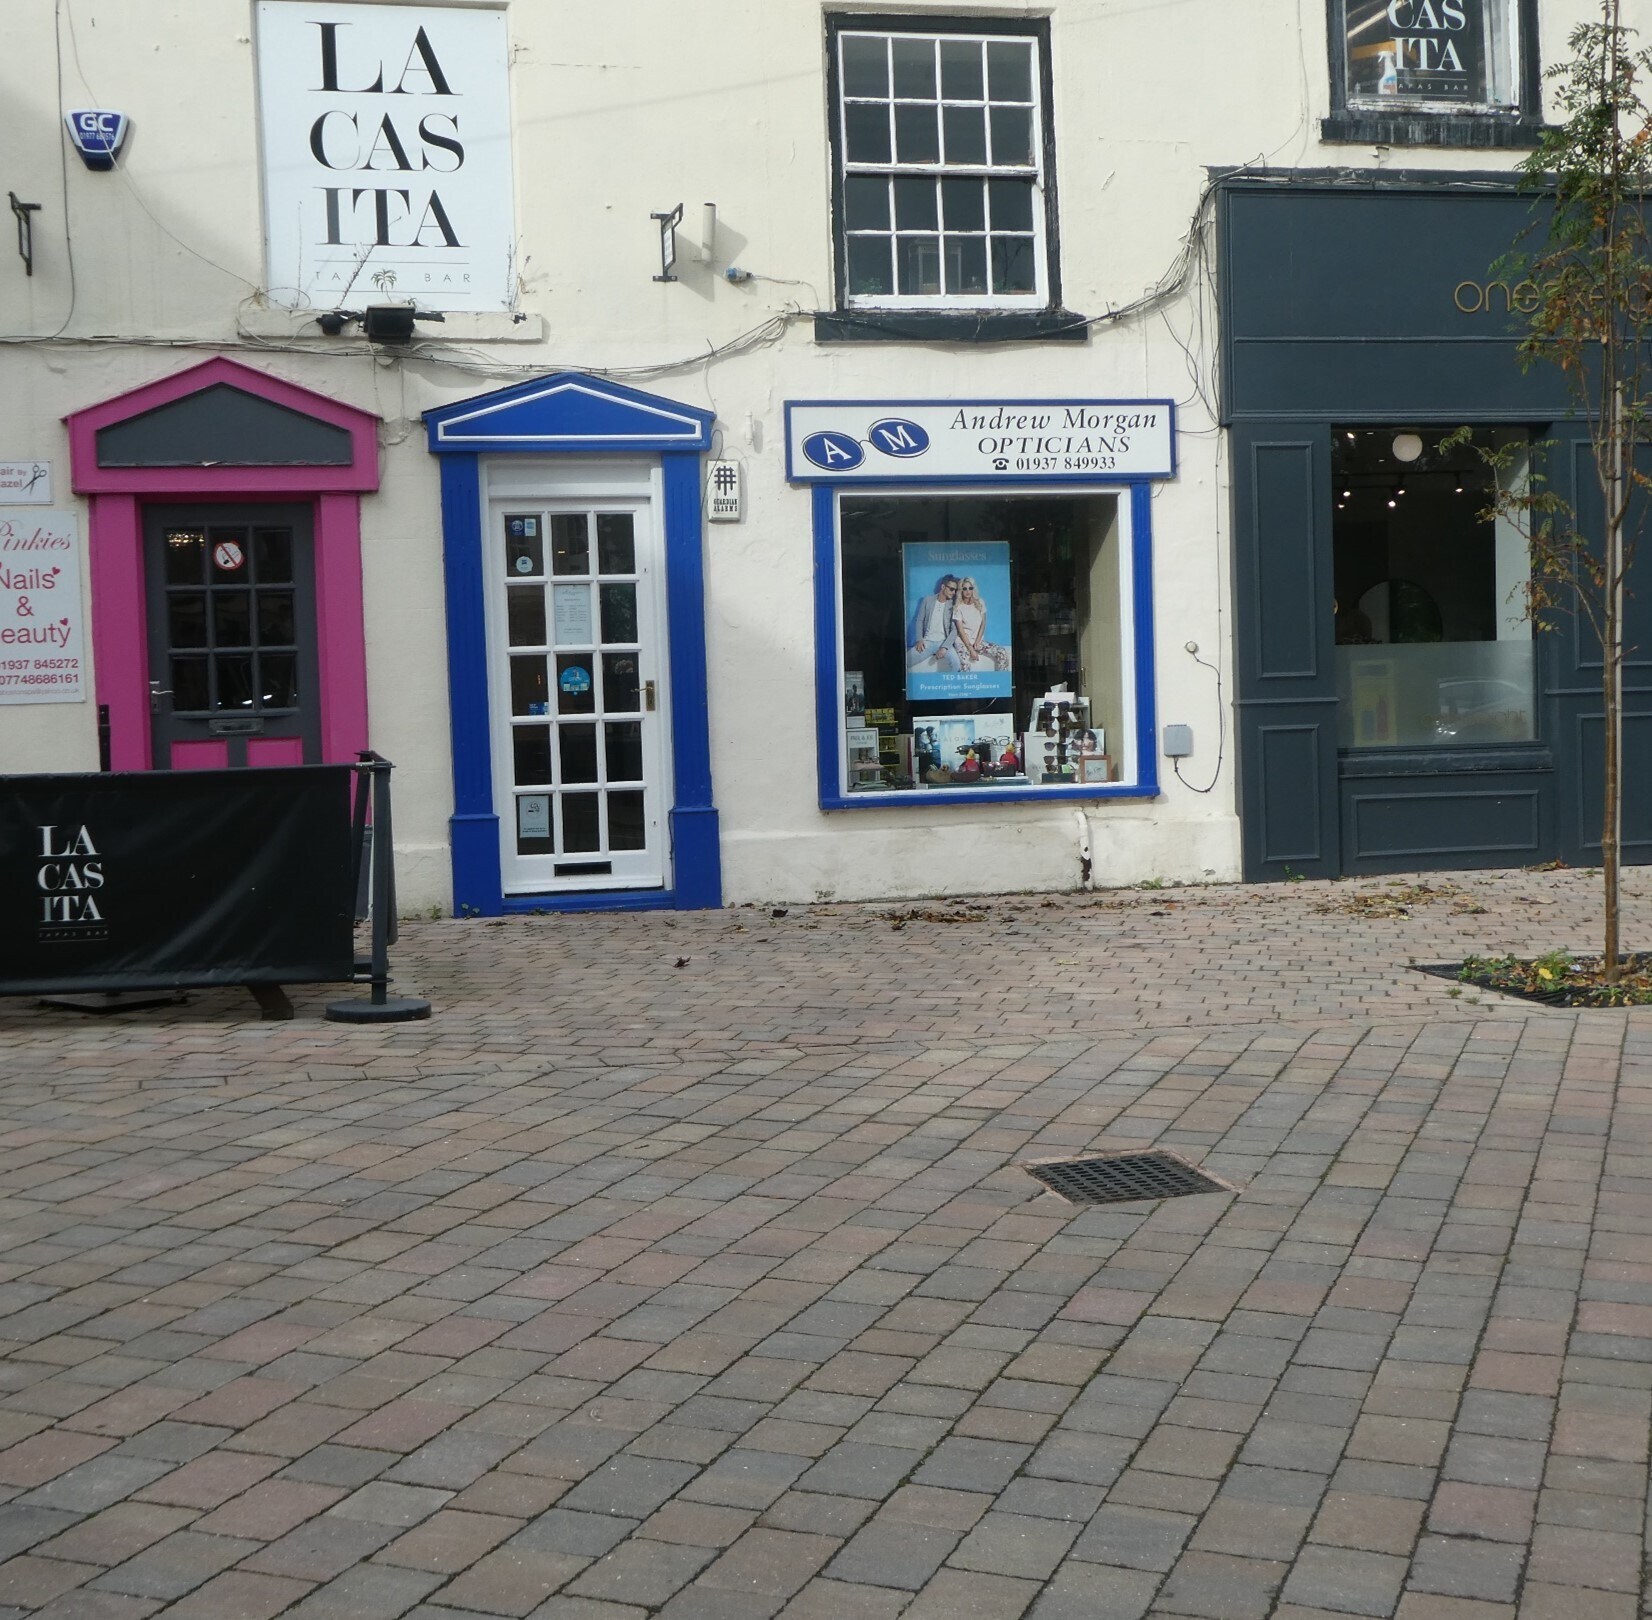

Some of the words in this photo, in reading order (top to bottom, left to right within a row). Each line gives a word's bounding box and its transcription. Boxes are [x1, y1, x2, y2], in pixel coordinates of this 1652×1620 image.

[1386, 0, 1466, 31] CAS
[304, 21, 464, 96] LA
[1389, 36, 1467, 71] ITA
[80, 113, 114, 132] GC
[309, 110, 465, 173] CAS
[312, 187, 471, 248] ITA
[424, 273, 471, 283] BAR
[949, 407, 1051, 430] Andrew
[1062, 408, 1157, 435] Morgan
[823, 437, 853, 464] A
[878, 425, 918, 452] M
[978, 436, 1131, 455] OPTICIANS
[0, 466, 15, 476] air
[1016, 458, 1058, 471] 01937
[1064, 457, 1116, 470] 849933
[0, 479, 23, 488] azel
[928, 548, 987, 561] Sunglasses
[16, 596, 35, 617] &
[0, 623, 71, 648] eauty
[0, 660, 30, 670] 1937
[34, 658, 79, 669] 845272
[0, 673, 79, 685] 07748686161
[920, 683, 960, 691] Prescription
[963, 682, 1000, 691] Sunglasses
[38, 825, 102, 857] LA
[38, 862, 105, 891] CAS
[40, 894, 106, 922] ITA
